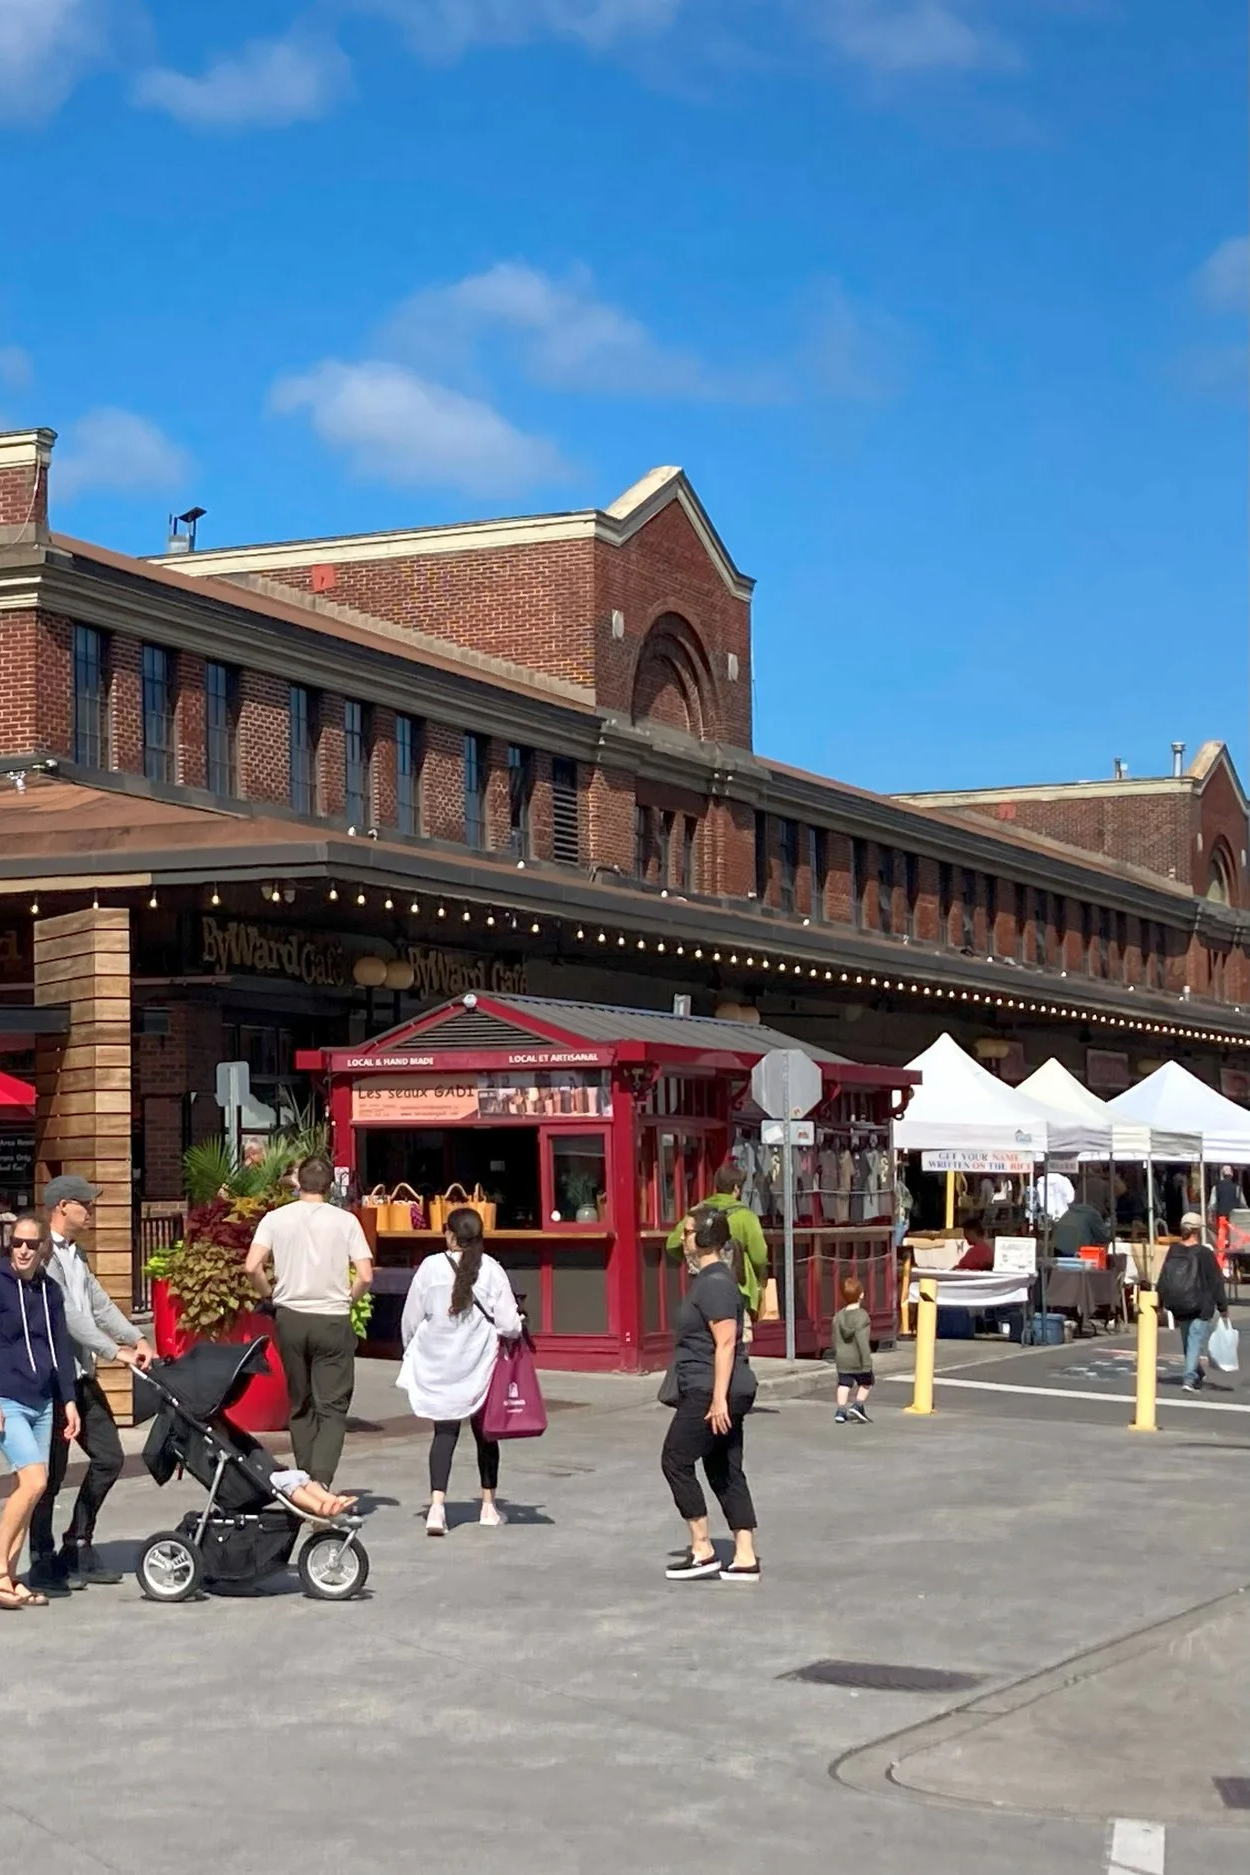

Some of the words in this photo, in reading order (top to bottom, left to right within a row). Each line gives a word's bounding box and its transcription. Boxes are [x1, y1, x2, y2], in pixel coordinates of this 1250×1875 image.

[201, 915, 301, 976] ByWard
[346, 1058, 375, 1067] LOCAL
[375, 1058, 383, 1067] &
[383, 1057, 409, 1066] HAND
[409, 1056, 435, 1066] MADE
[508, 1054, 537, 1064] LOCAL
[538, 1053, 549, 1063] ET
[550, 1052, 599, 1062] ARTISANAL
[358, 1085, 382, 1099] Les
[387, 1088, 428, 1099] seaux
[938, 1152, 956, 1161] GET
[961, 1152, 988, 1161] YOUR
[991, 1152, 1019, 1162] NAME
[928, 1160, 970, 1171] WRITTEN
[971, 1161, 987, 1171] ON
